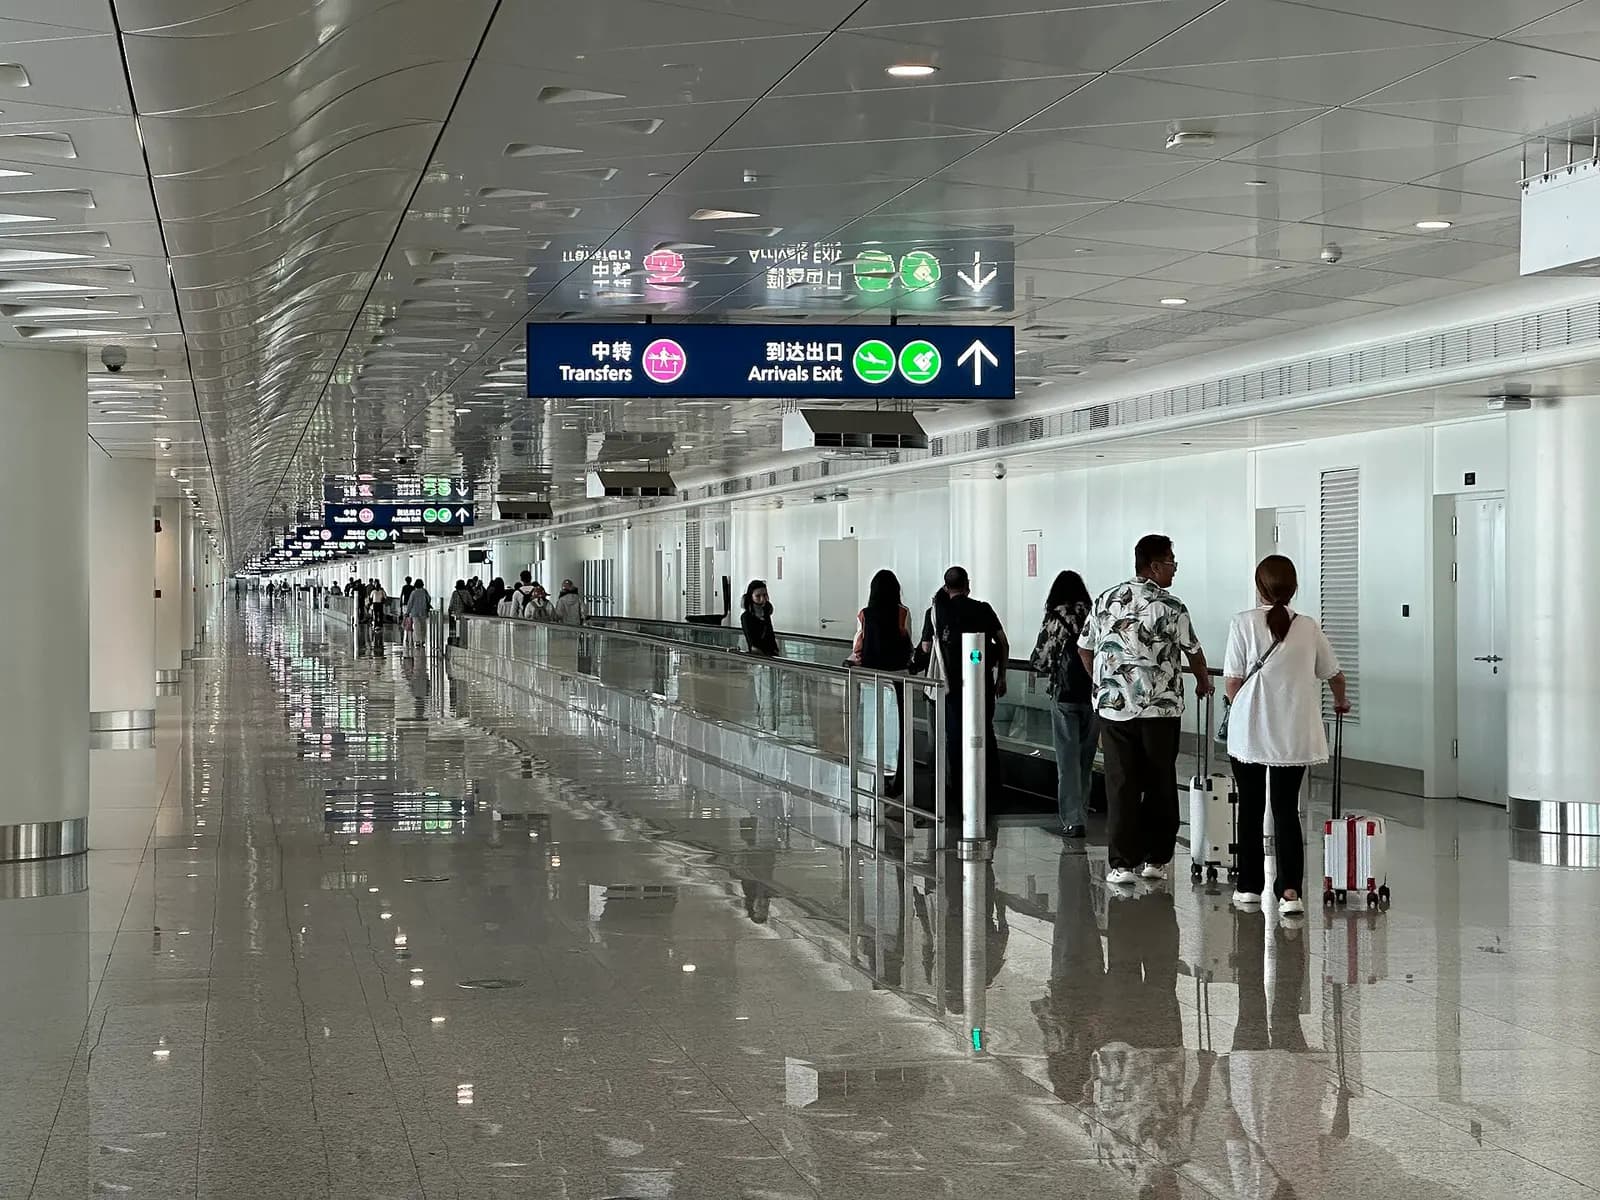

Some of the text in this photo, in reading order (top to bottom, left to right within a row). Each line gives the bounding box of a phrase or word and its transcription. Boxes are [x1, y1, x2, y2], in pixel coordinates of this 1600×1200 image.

[591, 341, 633, 362] 中转
[766, 342, 843, 362] 到达出口
[559, 365, 633, 382] Transfers
[748, 365, 843, 382] Arrivals Exit
